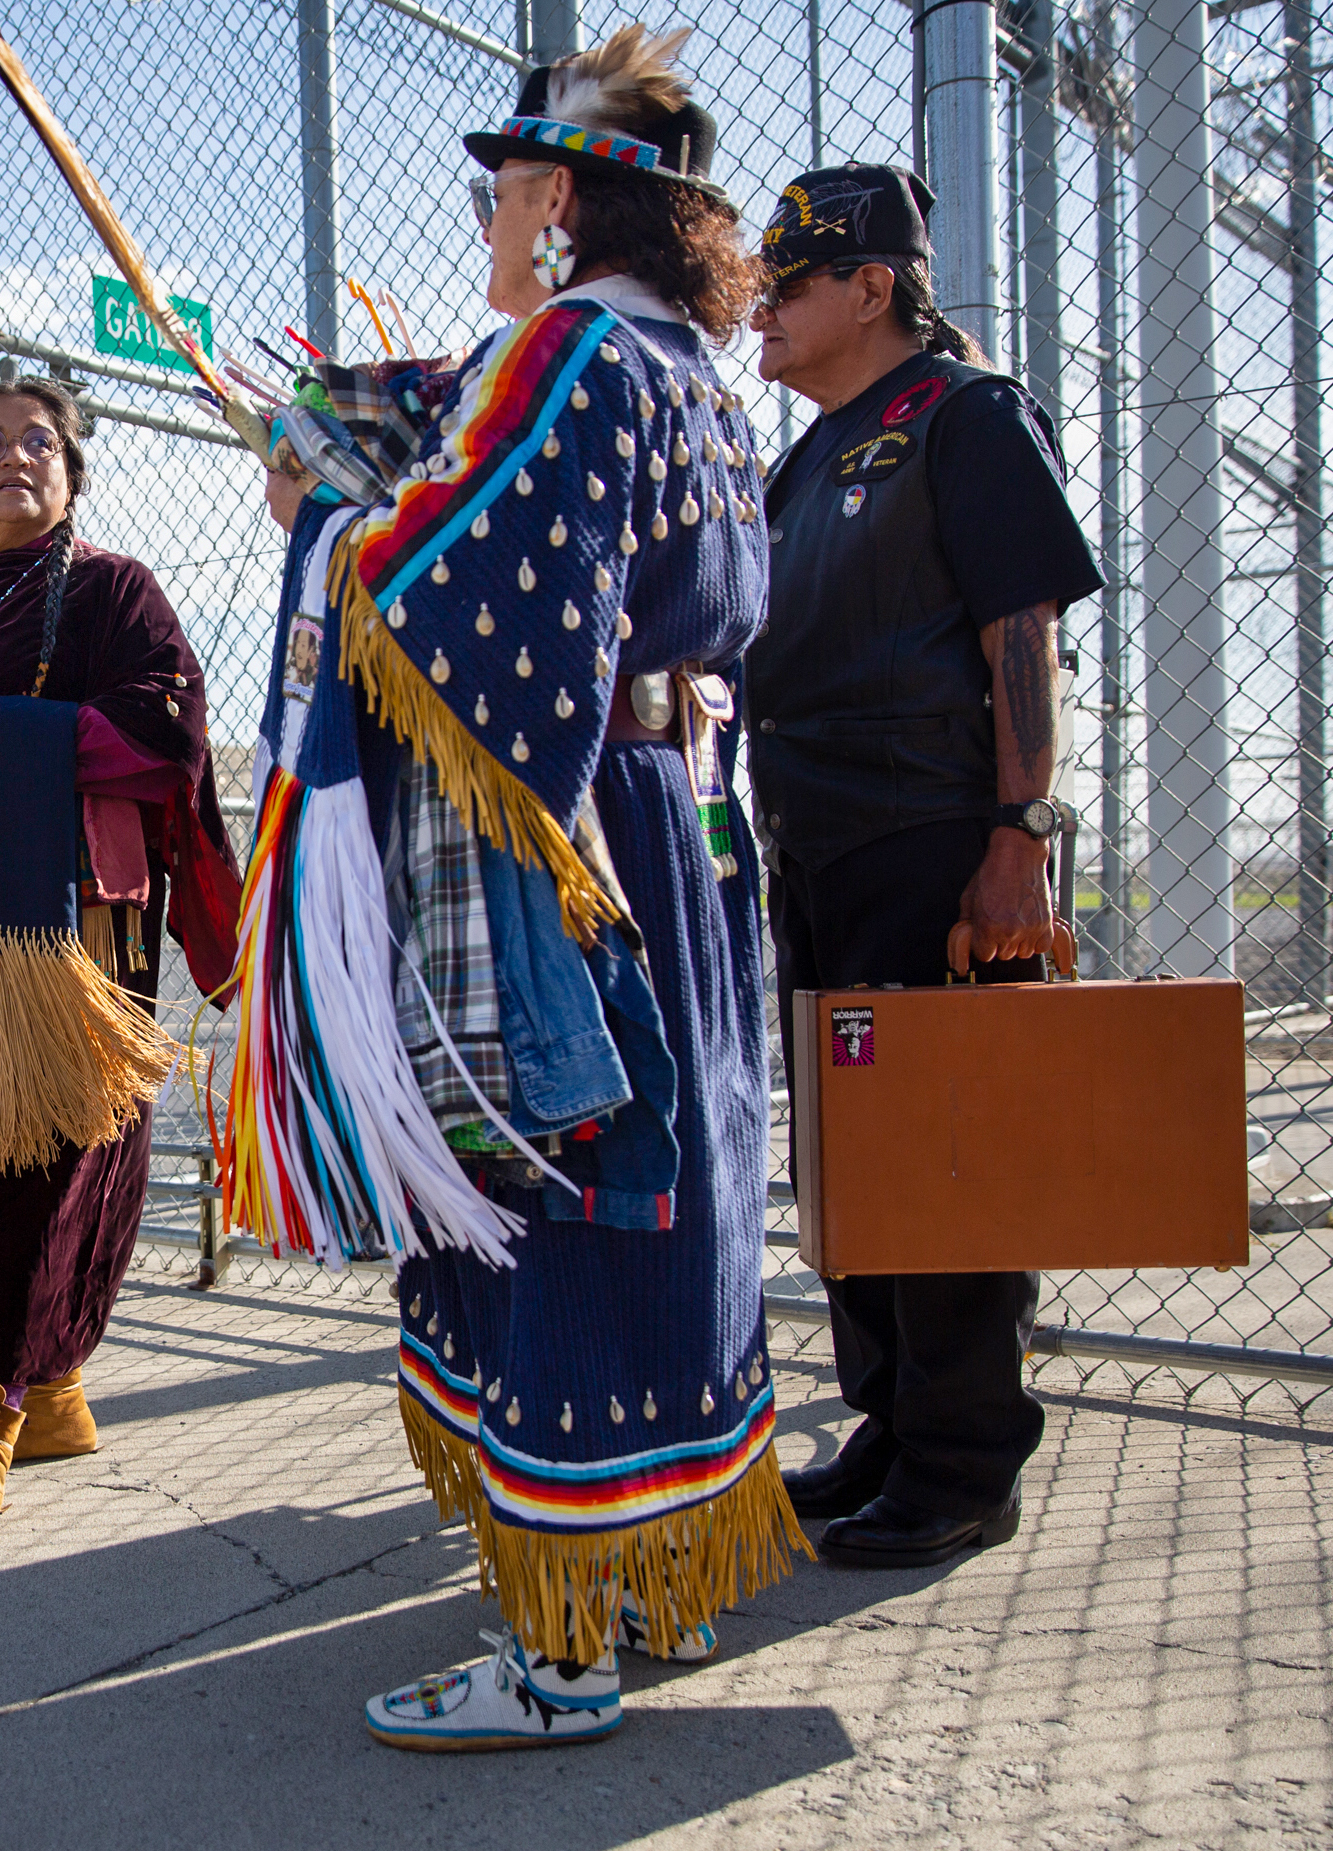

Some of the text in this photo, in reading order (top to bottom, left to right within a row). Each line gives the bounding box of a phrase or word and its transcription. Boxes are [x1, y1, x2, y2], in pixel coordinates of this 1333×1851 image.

[764, 257, 809, 283] ETERAN
[842, 432, 909, 461] NATIVE AMERICAN
[873, 458, 897, 467] VETERAN
[833, 1010, 873, 1019] WARRIOR
